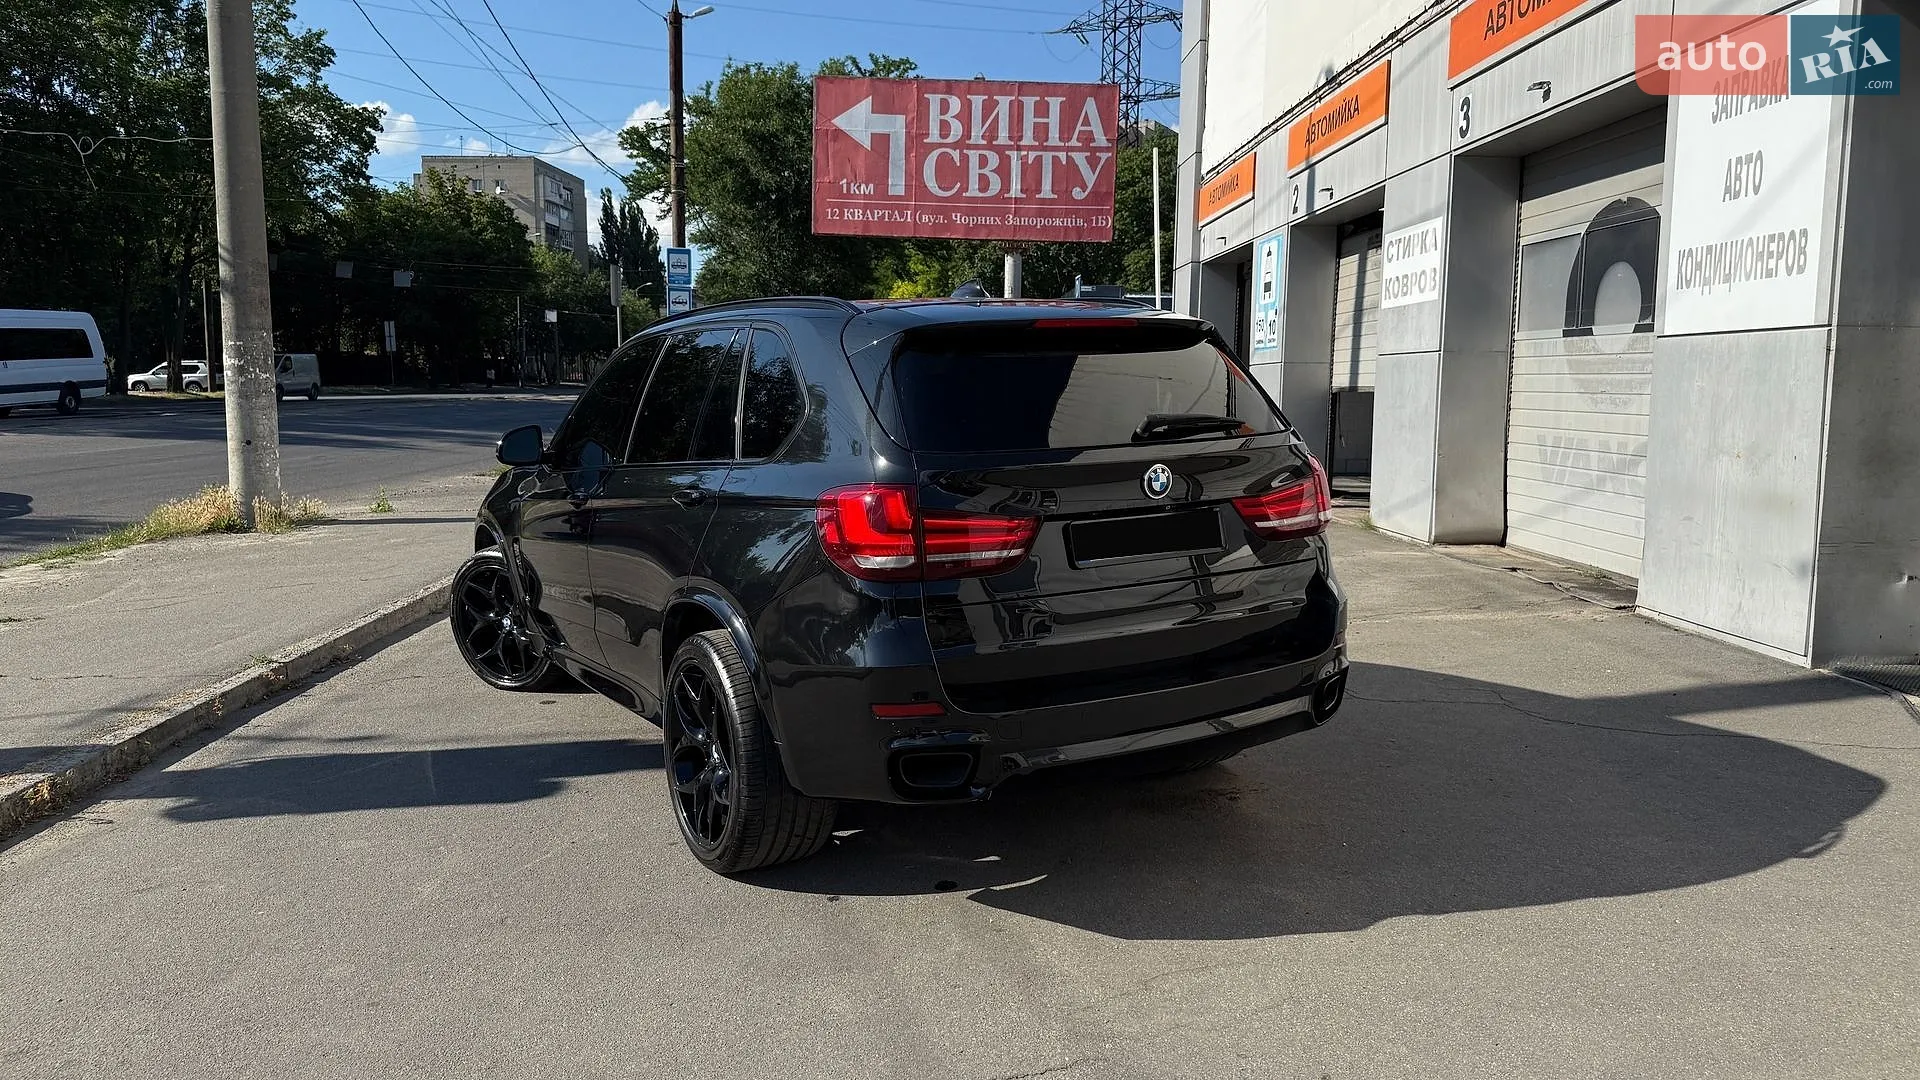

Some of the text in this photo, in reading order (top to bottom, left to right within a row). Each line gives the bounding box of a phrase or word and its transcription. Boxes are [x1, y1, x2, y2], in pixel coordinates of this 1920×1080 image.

[1712, 54, 1789, 124] ЗАПРАВКА
[923, 93, 1112, 147] ВИНА
[1305, 94, 1360, 148] АВТОМИЙКА
[1459, 96, 1471, 139] 3
[923, 148, 1112, 200] СВІТУ
[1208, 173, 1239, 206] АВТОМИЙКА
[1722, 150, 1764, 202] АВТО
[826, 208, 1112, 229] 12 КВАРТАЛ (вул. Чорних Запорожців, 1Б)
[1293, 184, 1299, 214] 2
[1387, 227, 1438, 263] СТИРКА
[1676, 228, 1808, 296] КОНДИЦИОНЕРОВ
[1384, 267, 1438, 300] КОВРОВ
